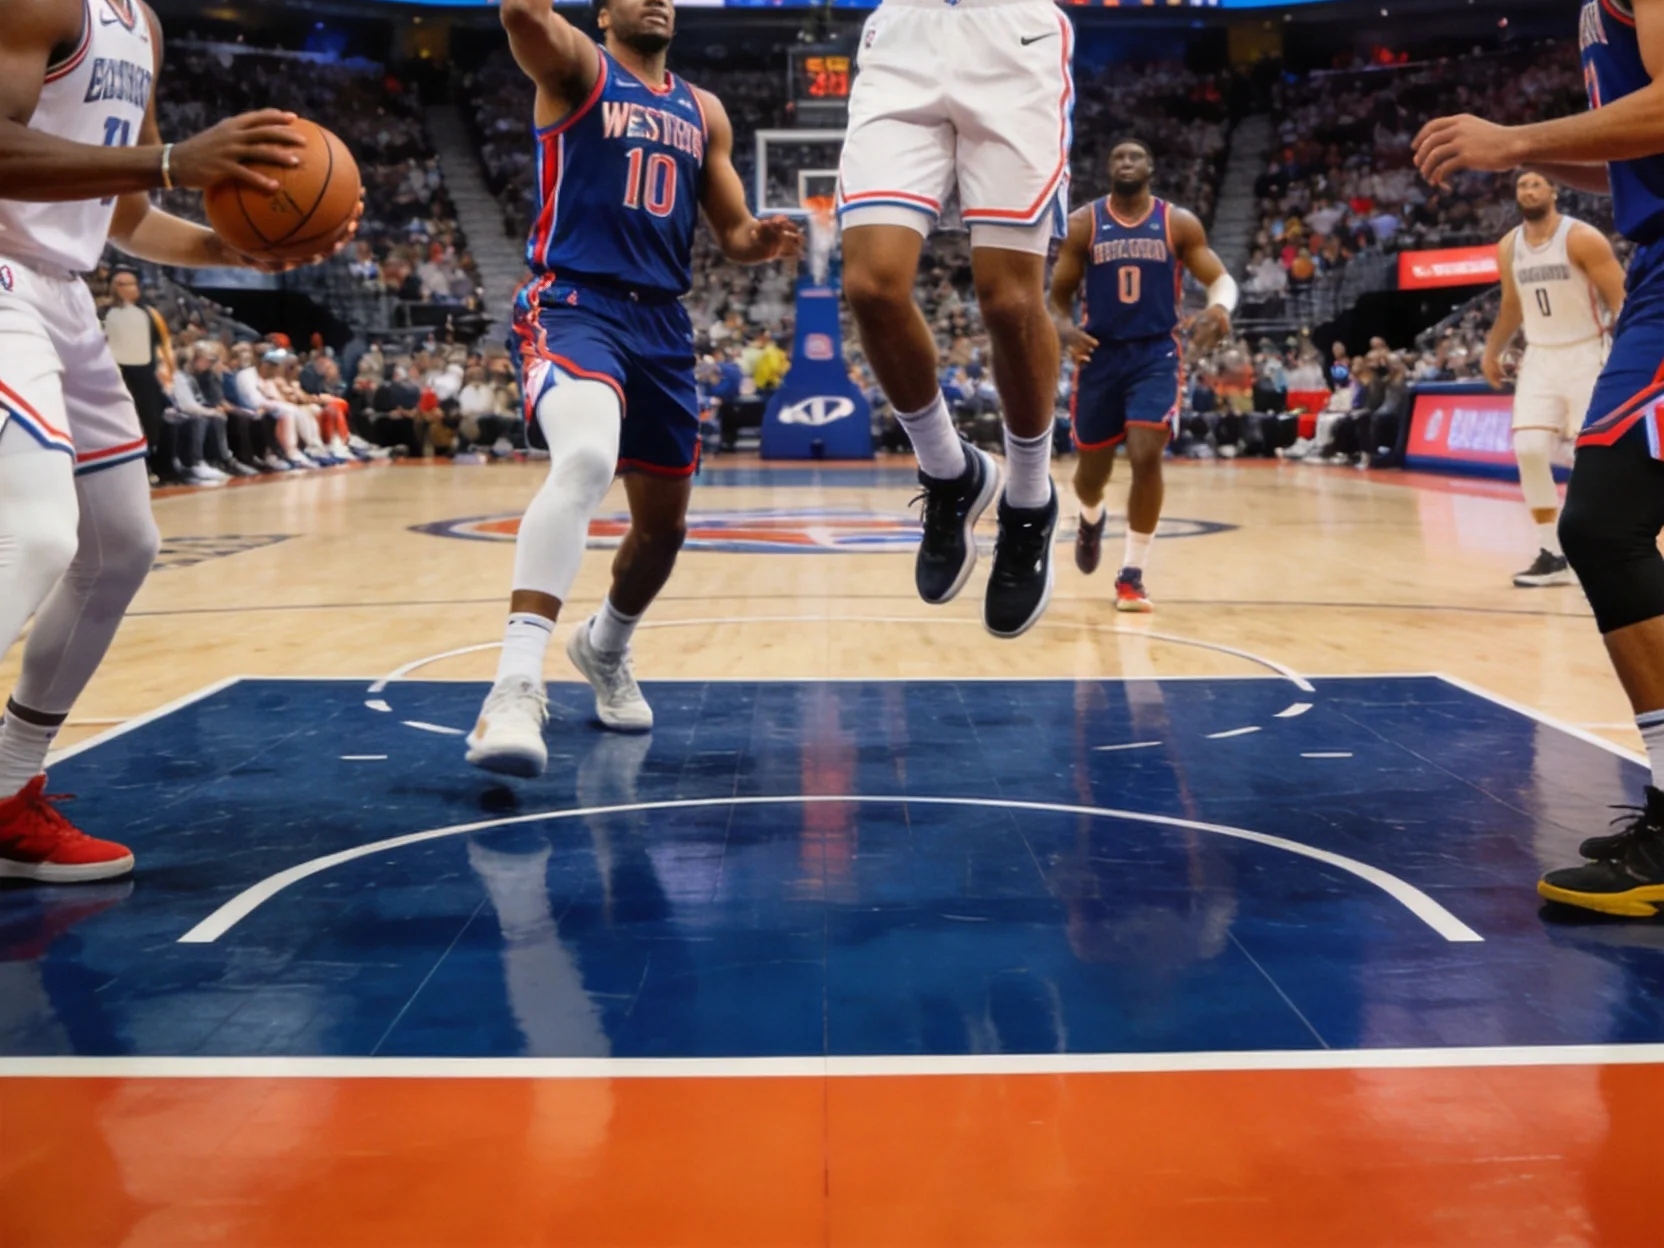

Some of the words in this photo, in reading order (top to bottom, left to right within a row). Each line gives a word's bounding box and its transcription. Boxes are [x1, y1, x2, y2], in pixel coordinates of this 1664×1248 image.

[623, 147, 677, 218] 10
[1118, 265, 1141, 304] 0
[1535, 288, 1552, 317] 0
